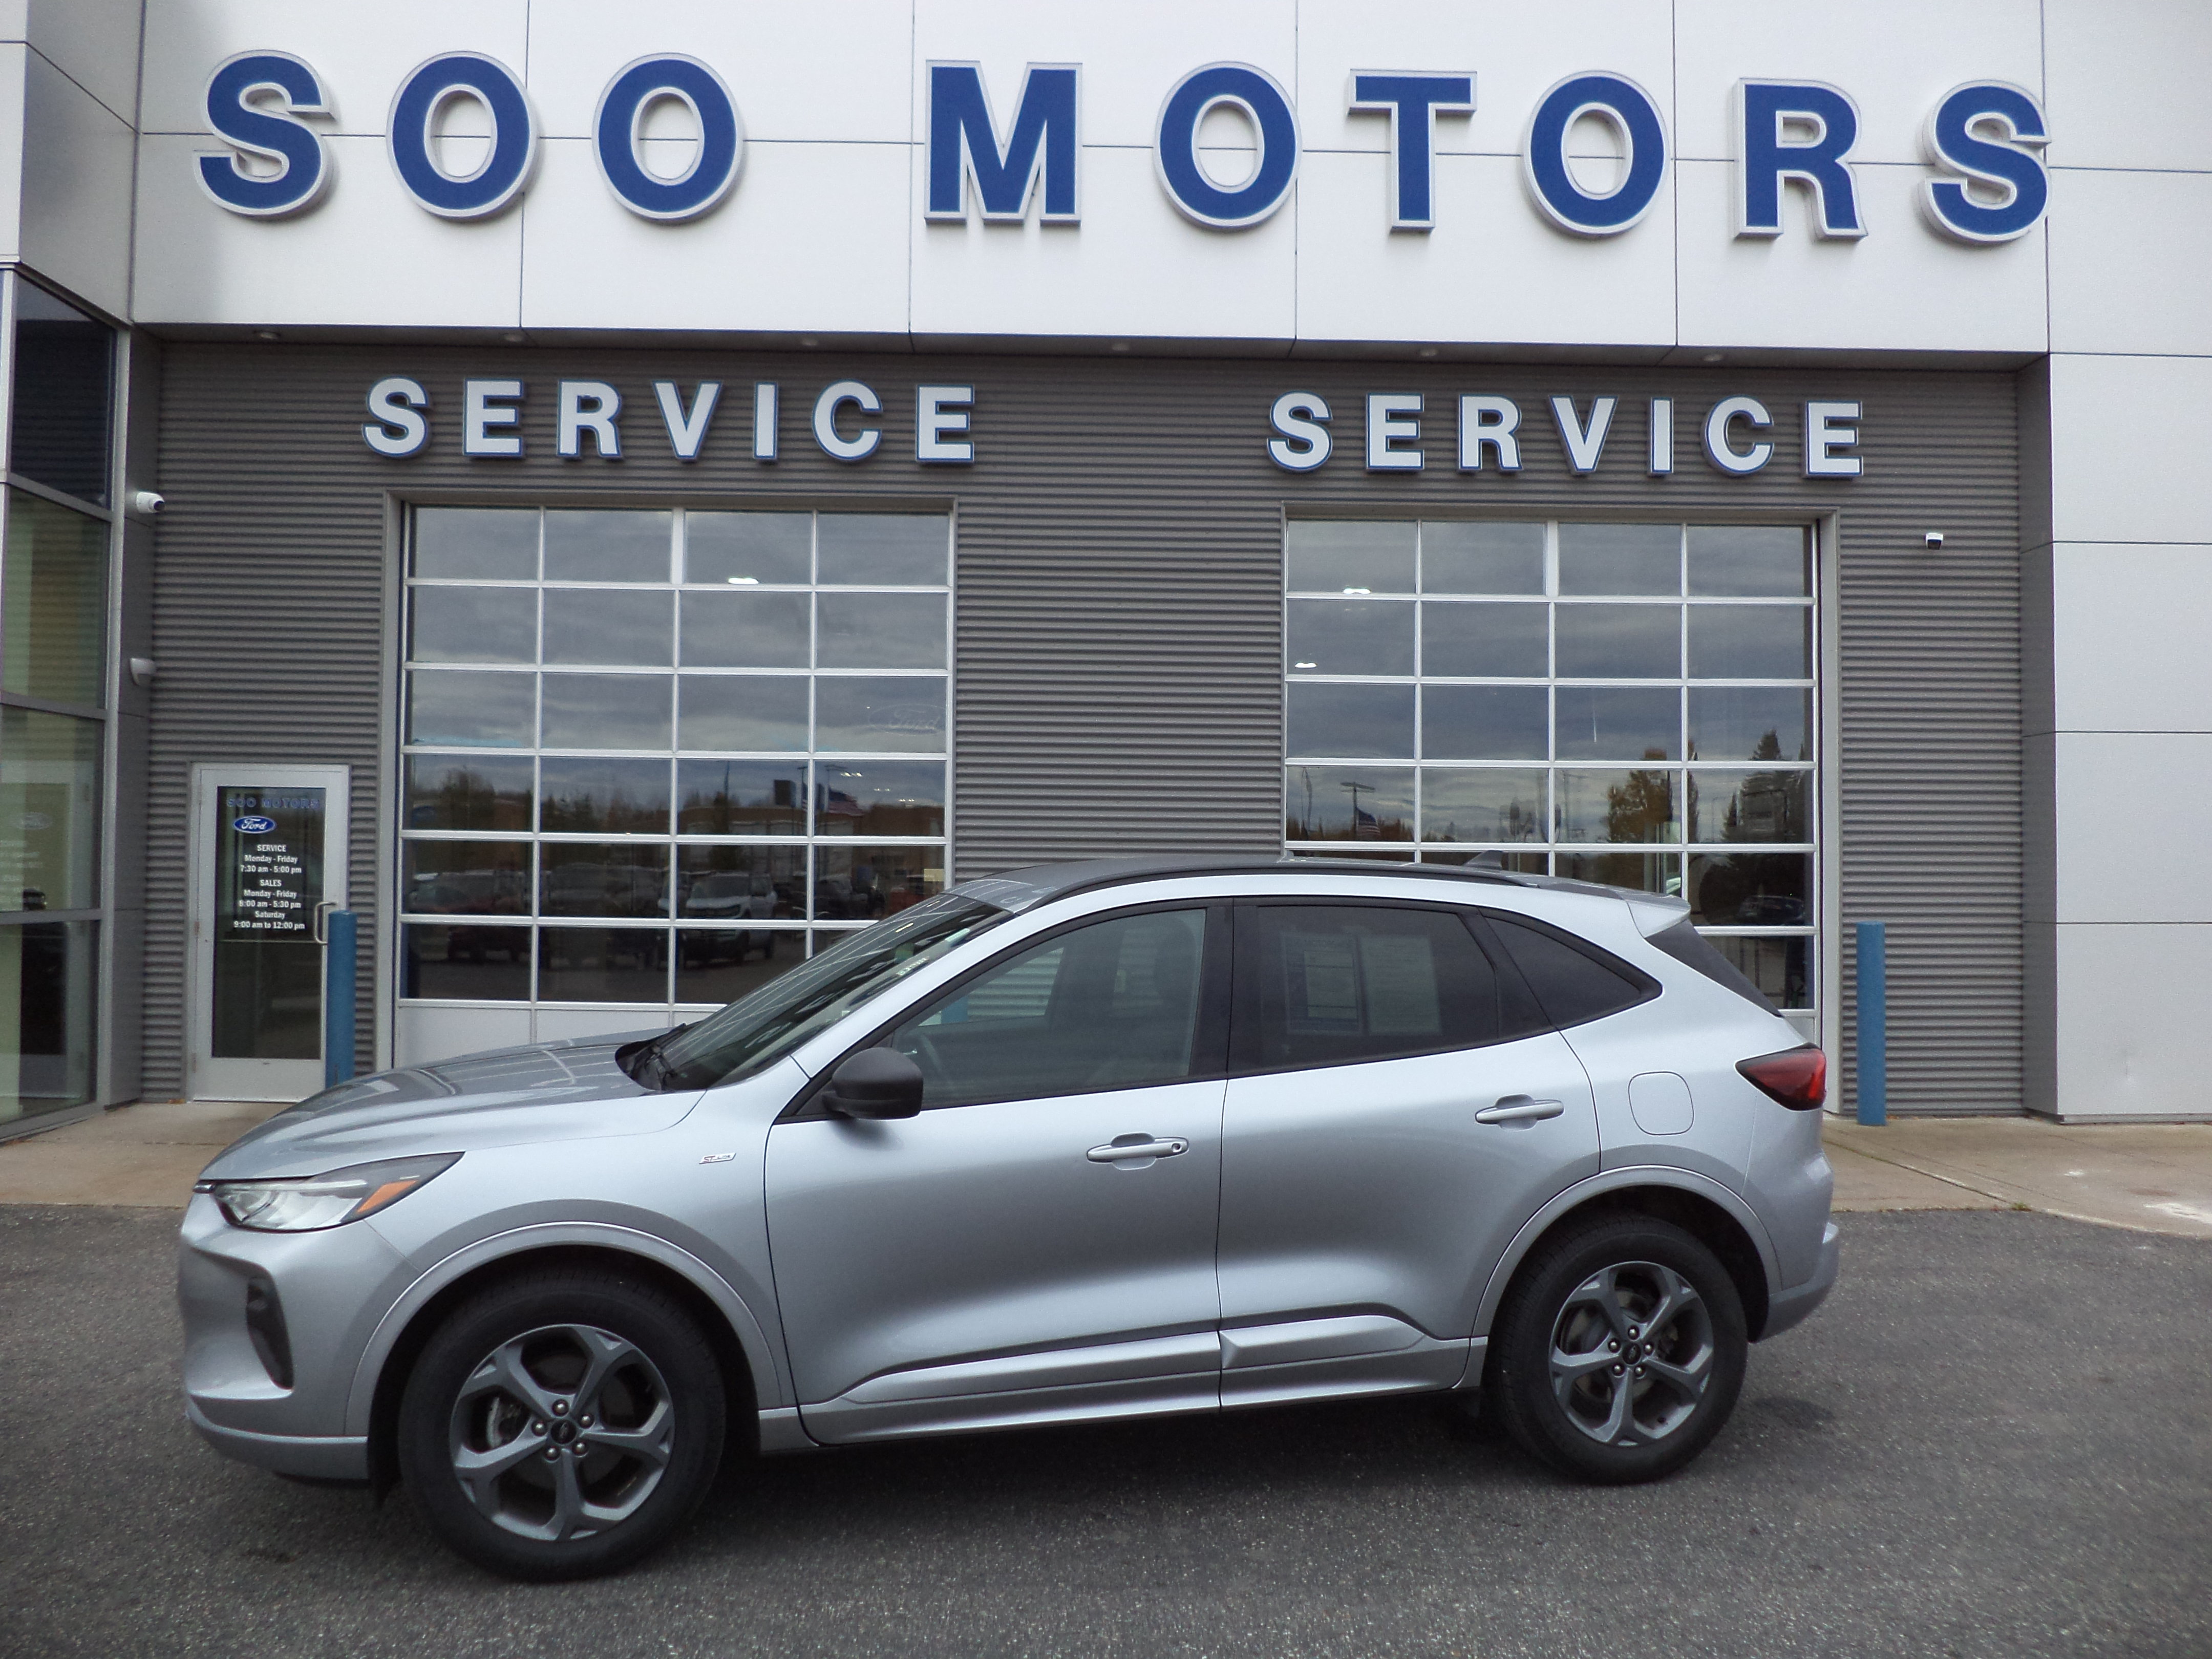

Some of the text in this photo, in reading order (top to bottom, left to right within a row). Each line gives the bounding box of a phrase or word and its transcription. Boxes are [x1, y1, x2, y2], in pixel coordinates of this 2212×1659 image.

[193, 49, 2050, 244] SOO MOTORS
[362, 377, 974, 462] SERVICE
[1267, 391, 1863, 478] SERVICE
[227, 797, 320, 809] SOO MOTORS
[241, 818, 267, 830] Ford
[245, 855, 272, 863] Monday
[278, 855, 297, 864] Friday
[244, 889, 271, 898] Monday
[276, 890, 297, 899] Friday
[255, 911, 285, 920] Saturday
